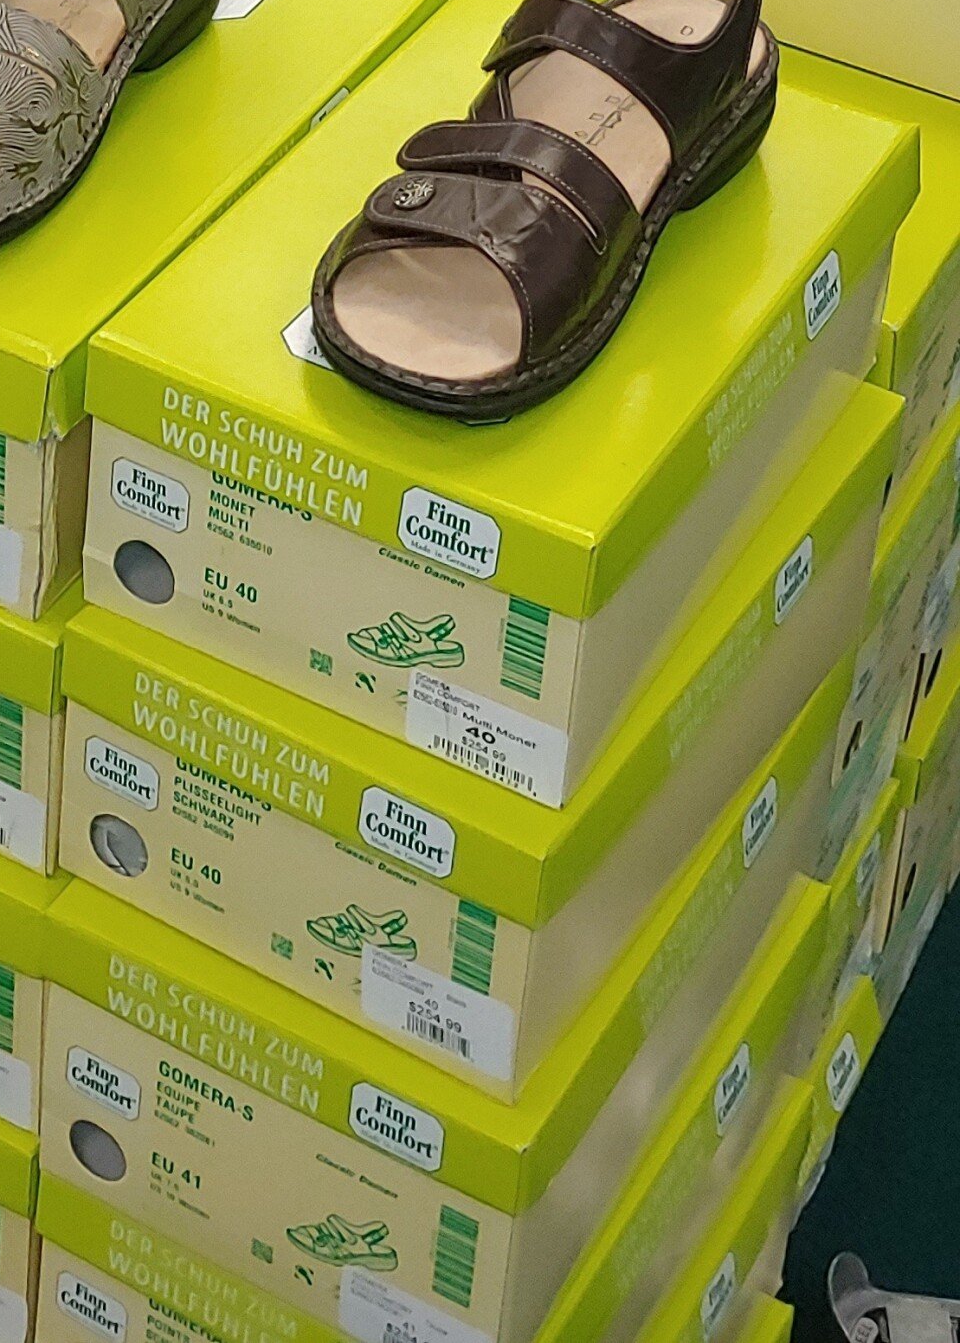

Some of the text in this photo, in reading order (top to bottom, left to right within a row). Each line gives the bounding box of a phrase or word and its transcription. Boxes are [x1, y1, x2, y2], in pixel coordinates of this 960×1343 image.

[163, 386, 369, 491] DER SCHUH ZUM
[131, 468, 167, 496] Finn
[161, 417, 363, 527] WOHLFÜHLEN
[116, 480, 183, 521] Comfort
[209, 505, 249, 532] MULTI
[210, 490, 255, 518] MONET
[426, 501, 472, 536] Finn
[406, 517, 491, 566] Comfort
[205, 567, 257, 603] EU 40
[135, 671, 331, 785] DER SCHUH ZUM
[462, 712, 537, 750] Multi Monet
[465, 726, 496, 745] 40
[90, 758, 153, 800] Comfort
[104, 747, 138, 777] Finn
[134, 702, 325, 819] WOHLFÜHLEN
[174, 776, 262, 826] PLISSEELIGHT
[174, 791, 234, 829] SCHWARZ
[385, 799, 428, 835] Finn
[366, 813, 445, 864] Comfort
[171, 848, 221, 884] EU 40
[108, 953, 324, 1081] DER SCHUH ZUM
[107, 986, 320, 1113] WOHLFÜHLEN
[155, 1096, 196, 1126] TAUPE
[156, 1083, 201, 1112] EQUIPE
[158, 1061, 255, 1123] GOMERA-S
[374, 1096, 416, 1133] Finn
[355, 1109, 433, 1159] Comfort
[151, 1152, 202, 1190] EU 41
